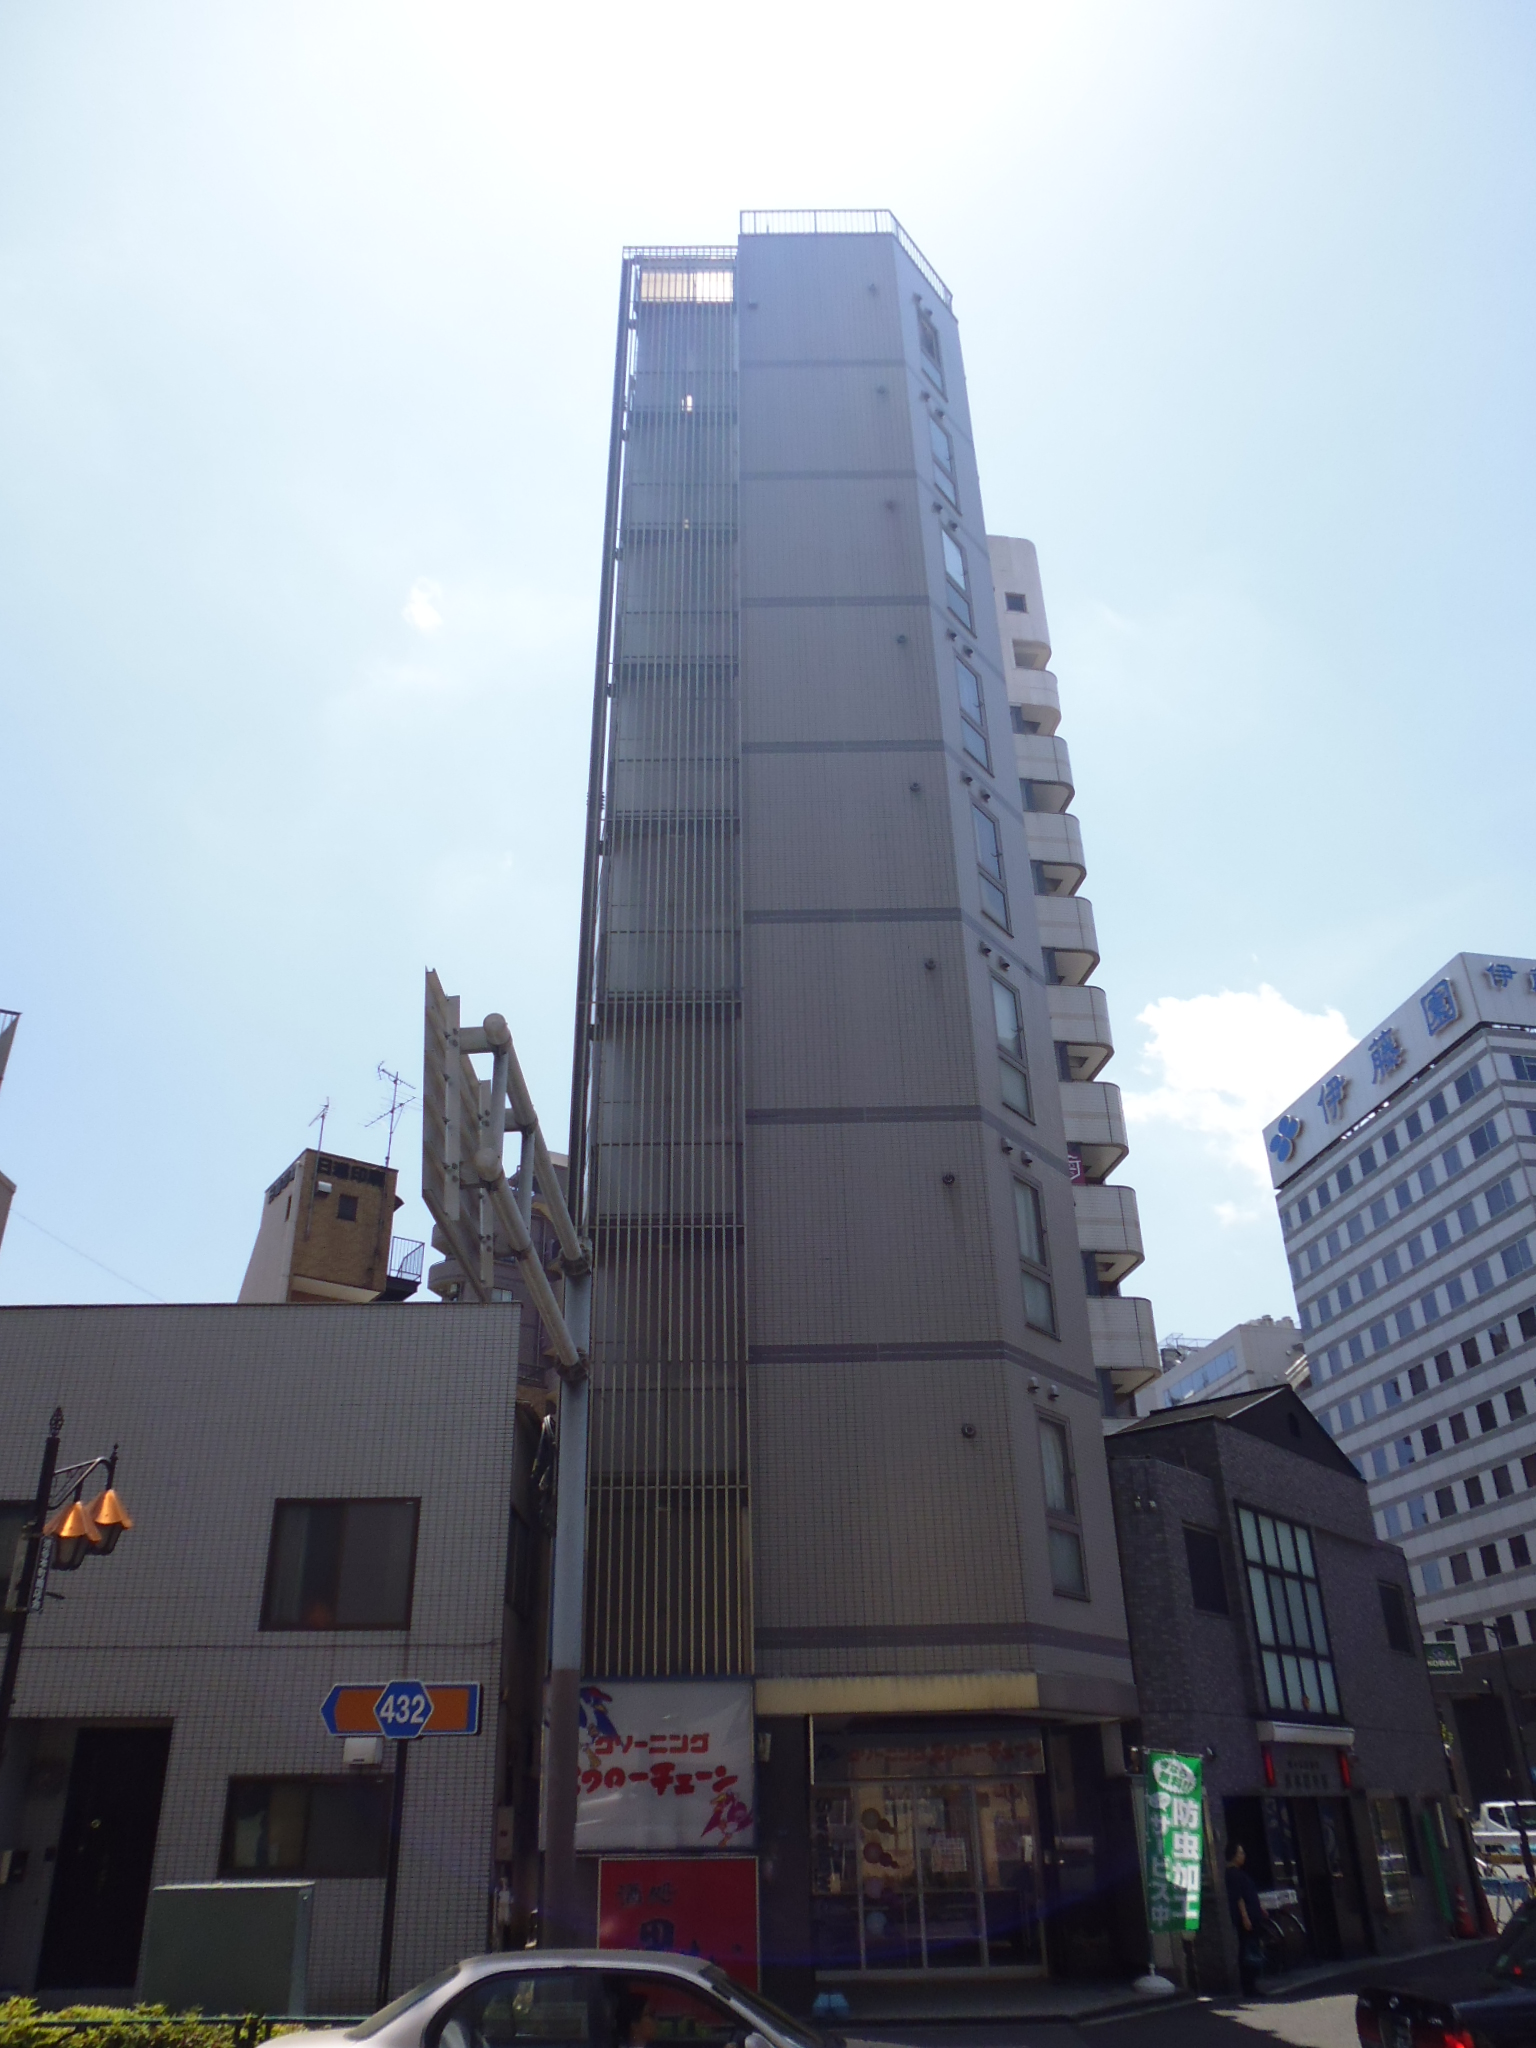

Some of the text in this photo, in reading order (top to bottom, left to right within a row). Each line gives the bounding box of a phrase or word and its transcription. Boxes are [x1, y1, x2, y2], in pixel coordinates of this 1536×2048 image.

[1486, 962, 1536, 993] 伊
[1317, 978, 1458, 1125] 伊藤園
[379, 1694, 426, 1724] 432
[595, 1733, 710, 1755] クリーニング
[577, 1762, 738, 1796] ワローチェーン
[1171, 1796, 1200, 1920] 防虫加工
